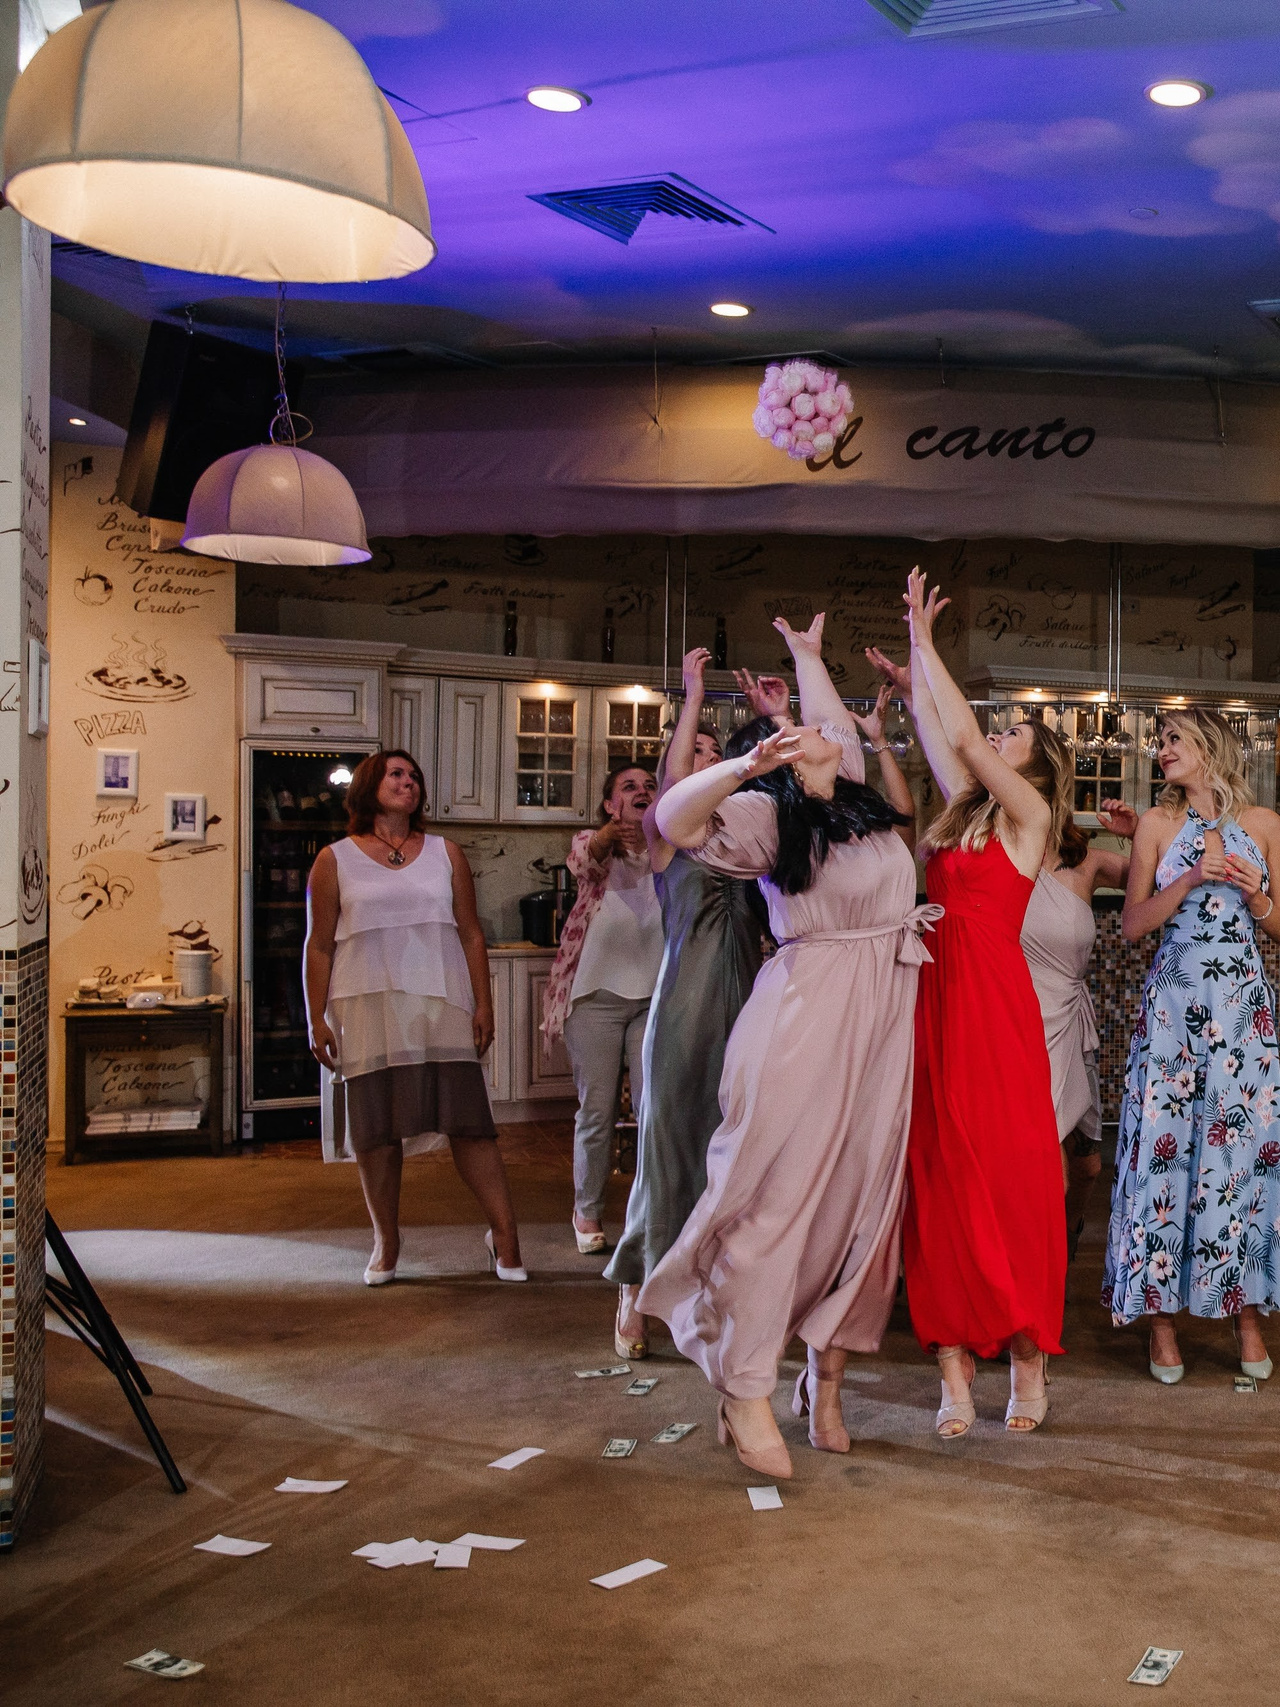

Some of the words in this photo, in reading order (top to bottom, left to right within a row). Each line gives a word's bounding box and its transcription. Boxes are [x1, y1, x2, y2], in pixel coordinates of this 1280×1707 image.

[906, 417, 1096, 460] canto
[128, 558, 226, 578] Toscana
[133, 576, 215, 596] Calzone
[134, 597, 200, 614] Crudo
[74, 710, 147, 746] PIZZA
[91, 803, 150, 829] Funghi
[72, 830, 130, 861] Dolci
[93, 965, 155, 986] Past
[97, 1058, 195, 1075] Toscana
[101, 1076, 184, 1094] Calzone
